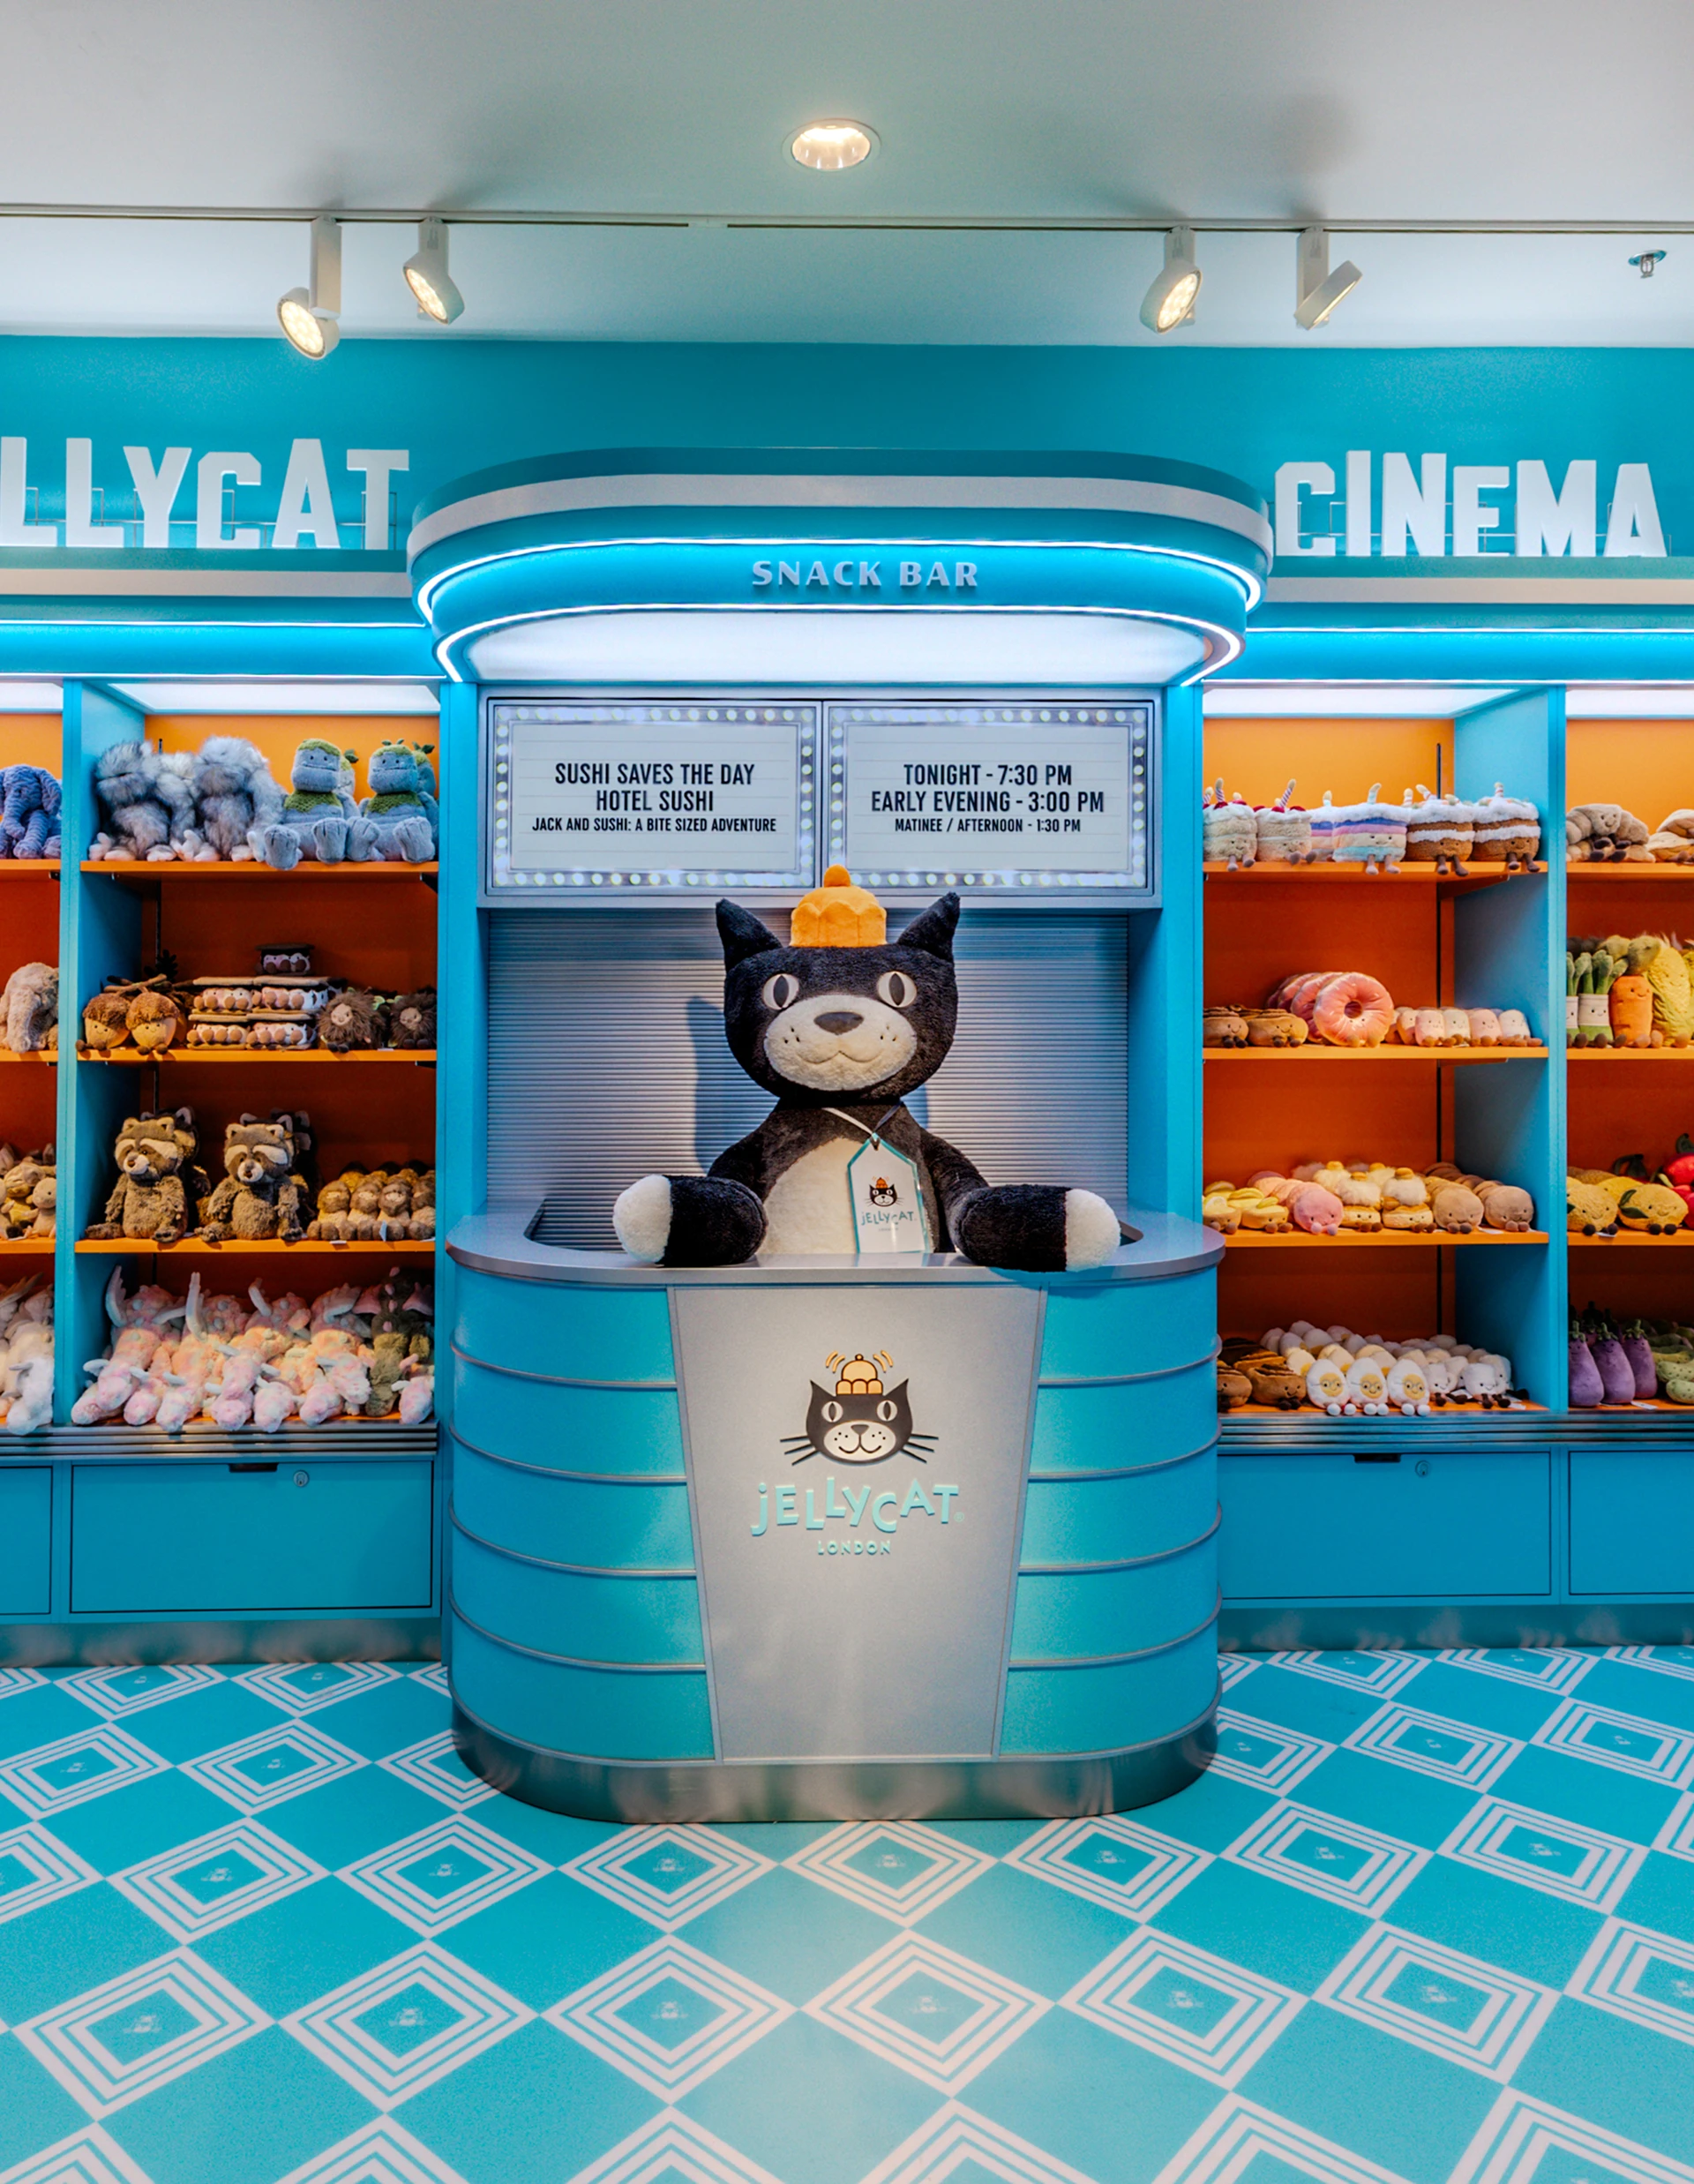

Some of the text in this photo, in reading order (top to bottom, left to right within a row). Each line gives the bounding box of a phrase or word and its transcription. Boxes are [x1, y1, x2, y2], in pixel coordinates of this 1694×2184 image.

[1275, 450, 1668, 557] CINEMA
[752, 560, 978, 587] SNACK BAR
[555, 762, 755, 784] SUSHI SAVES THE DAY
[903, 764, 981, 785] TONIGHT
[998, 764, 1038, 785] 7:30
[1046, 764, 1072, 785] PM
[596, 790, 714, 811] HOTEL SUSHI
[871, 791, 926, 812] EARLY
[933, 791, 1010, 812] EVENING
[1028, 791, 1069, 812] 3:00
[1077, 791, 1104, 812] PM
[532, 817, 776, 832] JACK AND SUSHI: A BITE SIZED ADVENTURE
[895, 818, 942, 832] MATINEE
[946, 817, 954, 832] /
[957, 818, 1023, 832] AFTERNOON
[1037, 818, 1060, 832] 1:30
[1064, 819, 1081, 832] PM
[817, 1540, 891, 1555] LONDON
